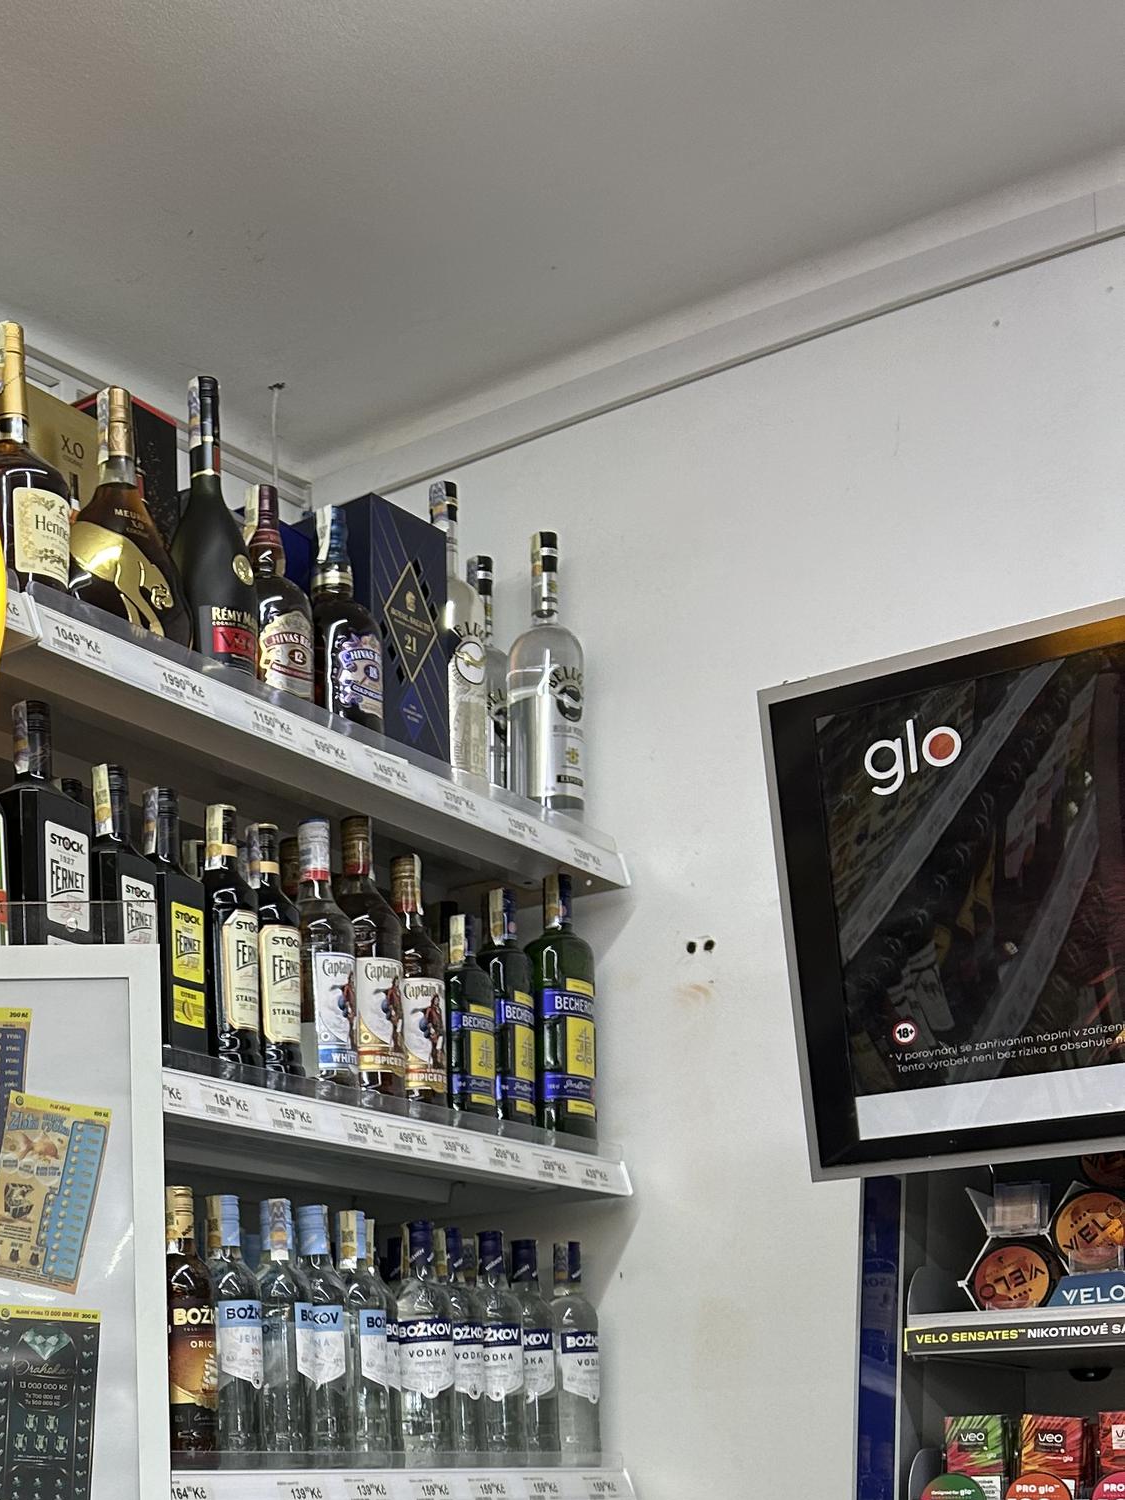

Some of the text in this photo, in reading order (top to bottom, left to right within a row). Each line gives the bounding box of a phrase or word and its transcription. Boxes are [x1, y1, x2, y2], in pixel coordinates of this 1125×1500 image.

[863, 718, 963, 796] glo
[50, 832, 85, 855] STOCK
[174, 910, 201, 926] STOCK
[896, 1027, 914, 1039] 18+
[916, 1333, 949, 1344] VELO
[1027, 1323, 1108, 1339] NIKOTINOVÉ
[408, 1348, 447, 1358] VODKA
